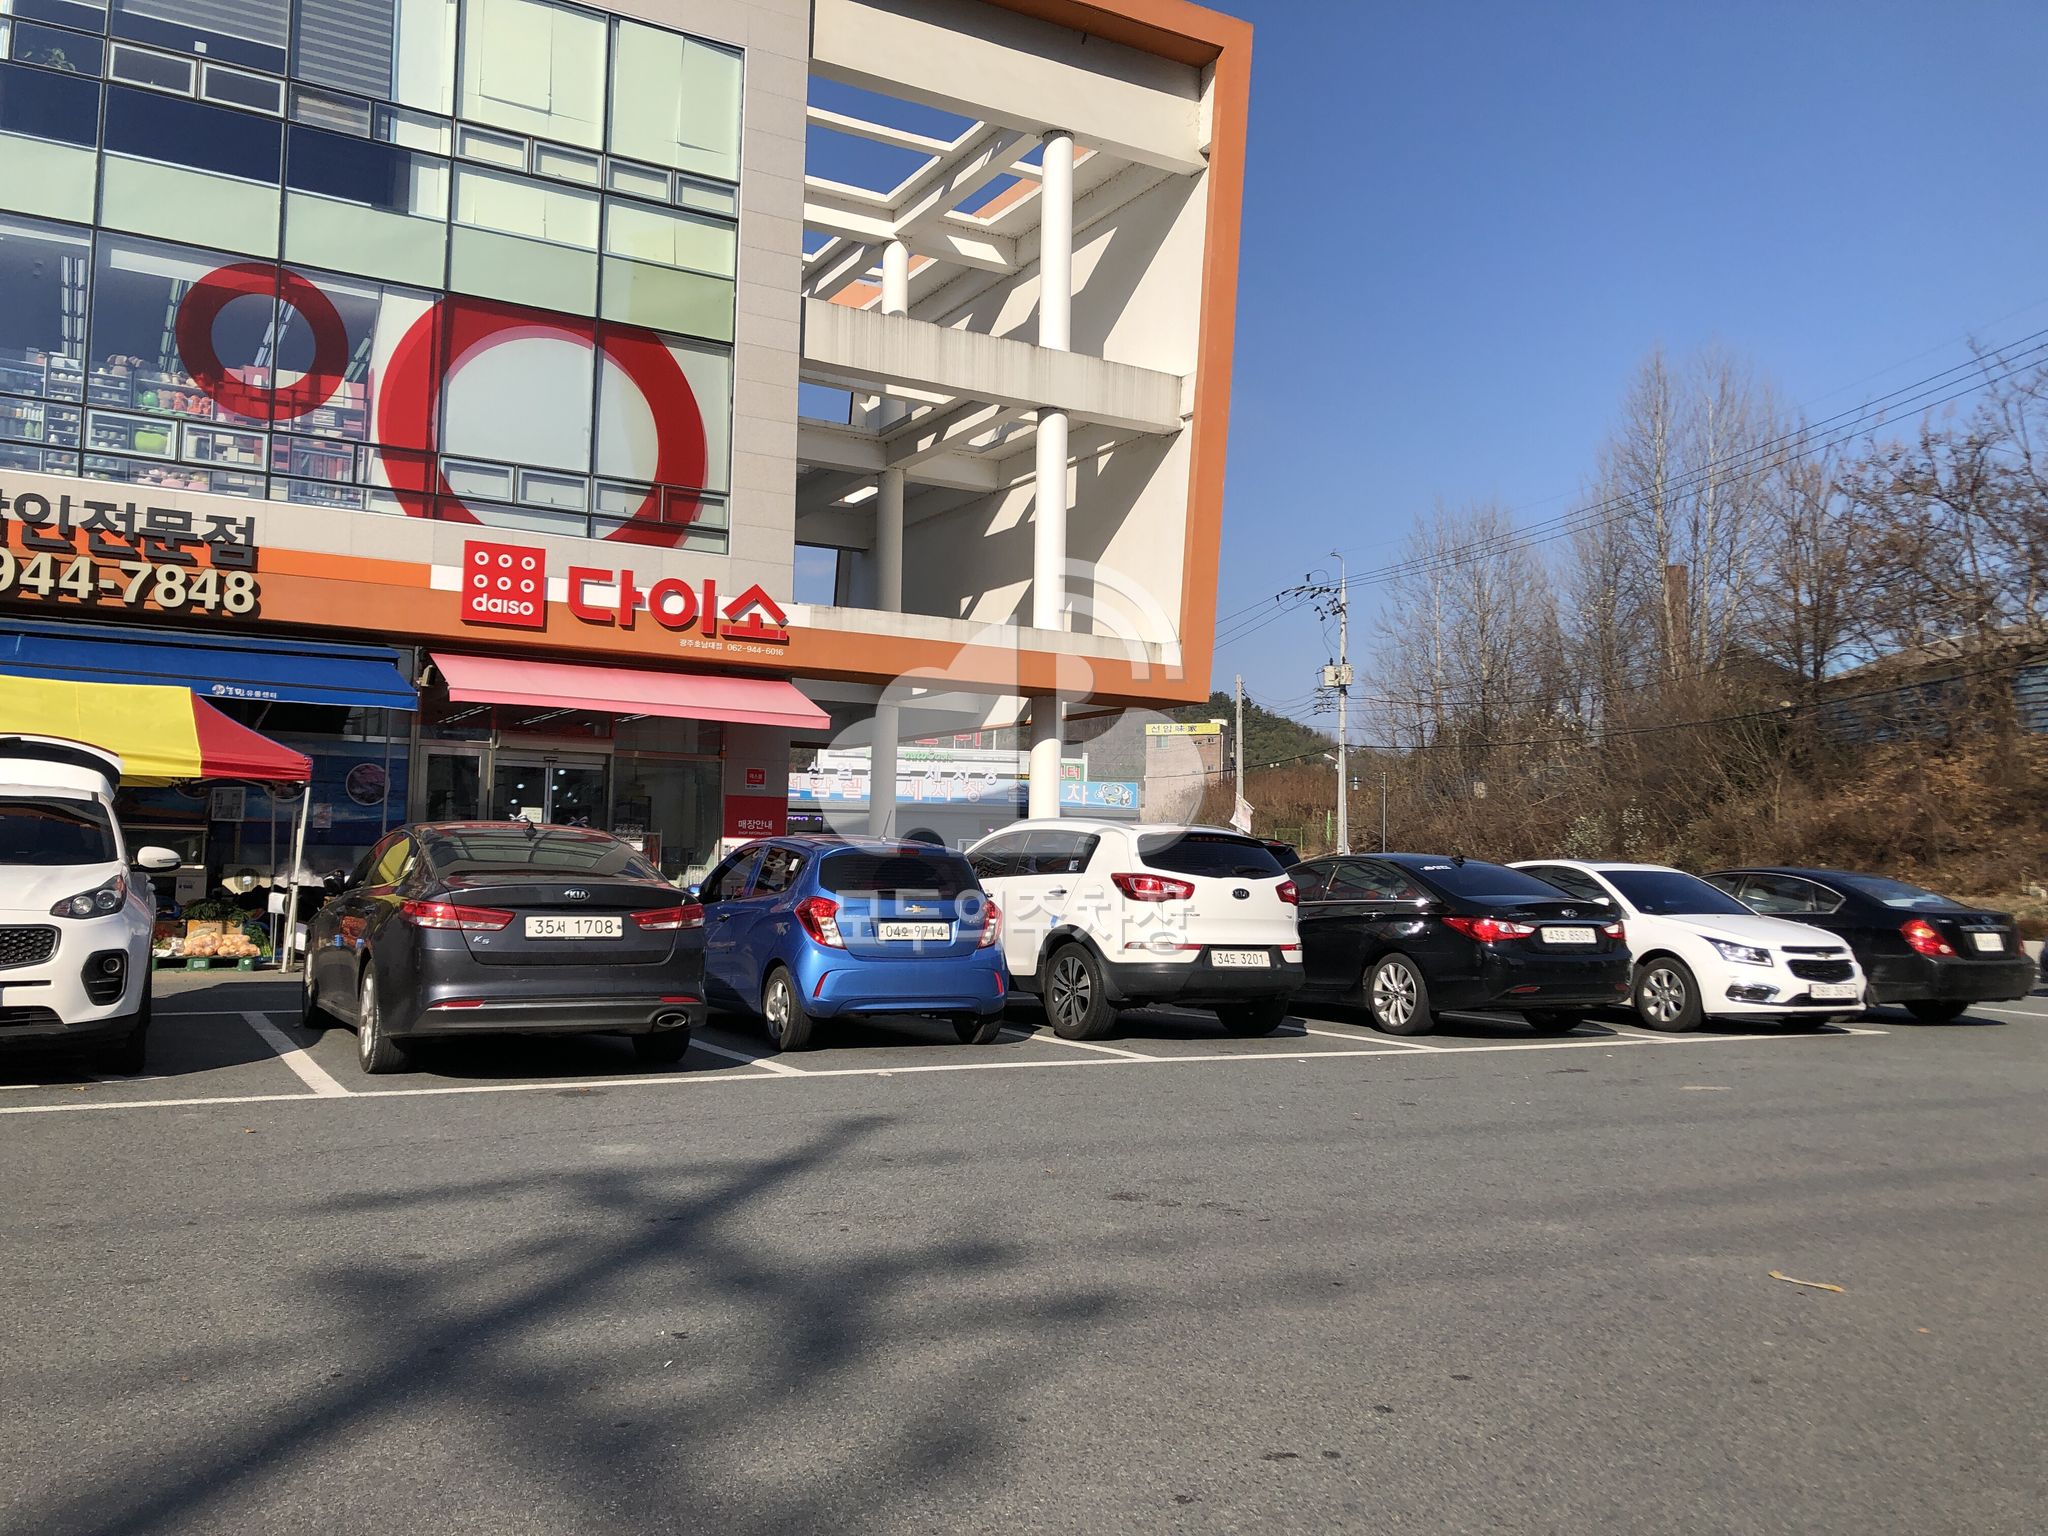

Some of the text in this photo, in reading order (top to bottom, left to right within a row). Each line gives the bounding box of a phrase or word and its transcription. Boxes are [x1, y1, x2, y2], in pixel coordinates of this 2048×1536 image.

[0, 489, 255, 566] 인전문점
[472, 592, 534, 616] daiso
[568, 565, 788, 641] 다이소
[727, 643, 784, 656] 062-944-6016
[738, 820, 773, 830] 매장안내
[569, 889, 587, 898] KIA
[534, 919, 614, 935] 35서 1708
[914, 926, 943, 938] 9714
[1241, 953, 1264, 965] 3201
